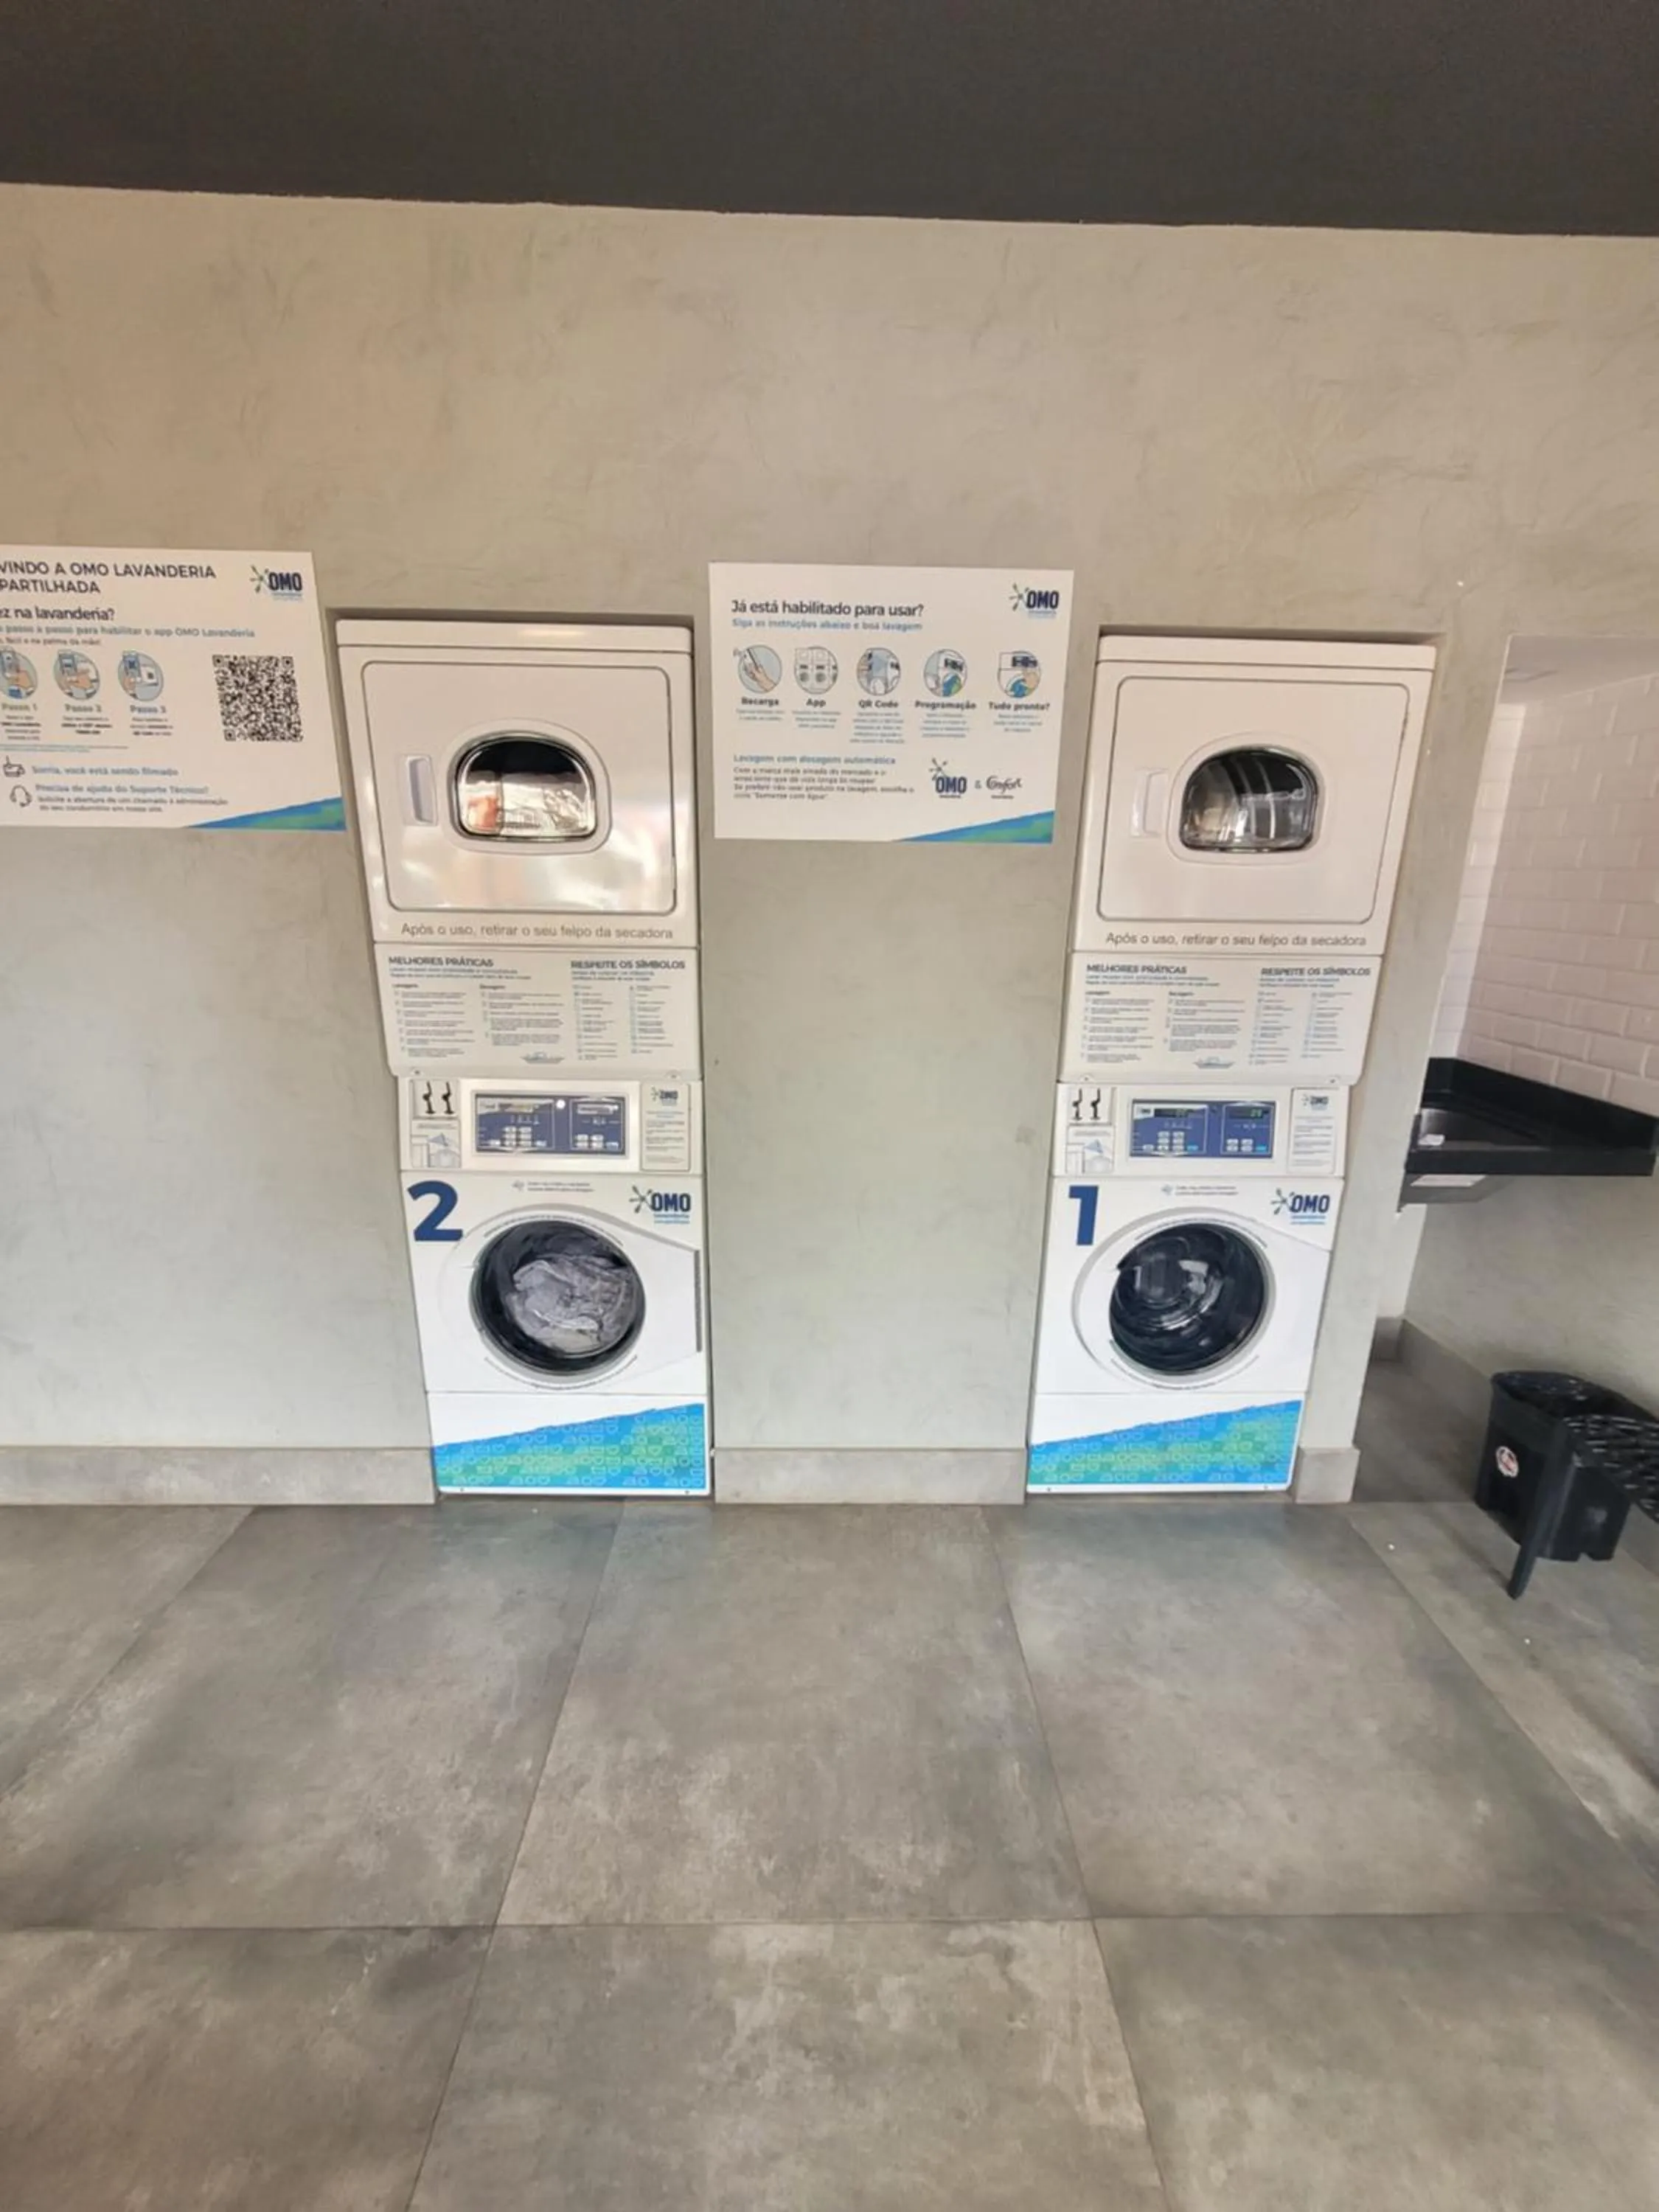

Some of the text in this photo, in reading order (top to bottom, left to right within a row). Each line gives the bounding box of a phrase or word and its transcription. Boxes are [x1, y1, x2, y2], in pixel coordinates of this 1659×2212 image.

[55, 562, 66, 574] A
[70, 563, 109, 577] OMO
[114, 563, 217, 579] LAVANDERIA
[0, 578, 100, 594] PARTILHADA
[268, 571, 302, 592] OMO
[1026, 590, 1060, 609] OMO
[15, 608, 32, 619] na
[35, 605, 115, 621] lavanderia?
[731, 599, 924, 618] Já está habilitado para usar?
[175, 628, 199, 636] OMO
[202, 628, 255, 638] Lavanderia
[806, 698, 827, 709] App
[858, 700, 899, 709] QR Code
[915, 700, 977, 710] Programação
[989, 702, 1050, 712] Tudo pronto?
[936, 776, 967, 793] OMO
[401, 923, 434, 937] Após
[437, 926, 446, 935] o
[450, 925, 477, 936] uso,
[481, 924, 518, 936] retirar
[521, 927, 530, 936] o
[533, 926, 557, 936] seu
[595, 925, 611, 937] da
[615, 926, 672, 939] secadora
[1106, 932, 1137, 948] Após
[1141, 935, 1150, 944] o
[1152, 935, 1178, 946] uso,
[1182, 932, 1217, 945] retirar
[1221, 936, 1229, 945] o
[1233, 936, 1255, 945] seu
[1292, 933, 1307, 945] da
[1311, 933, 1366, 946] secadora
[389, 956, 493, 967] MELHORES PRÁTICAS
[571, 959, 686, 970] RESPEITE OS SÍMBOLOS
[1086, 964, 1187, 975] MELHORES PRÁTICAS
[1261, 966, 1371, 976] RESPEITE OS SÍMBOLOS
[651, 1192, 692, 1212] OMO
[1290, 1194, 1330, 1214] OMO
[407, 1180, 463, 1242] 2
[1068, 1185, 1099, 1245] 1
